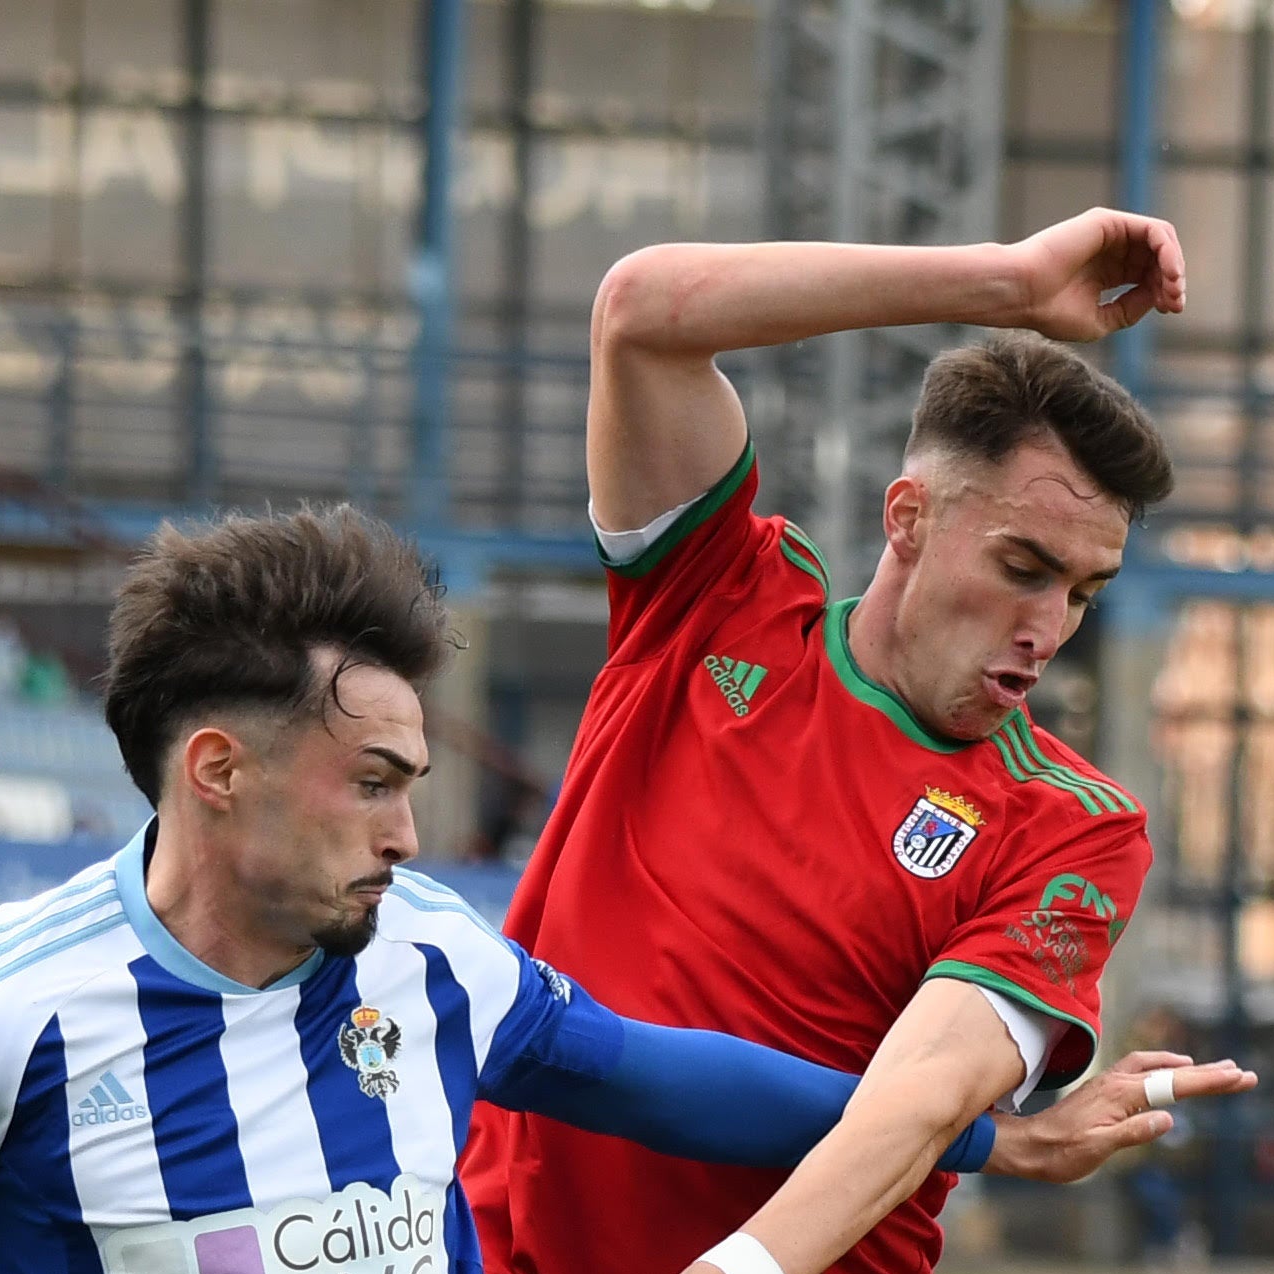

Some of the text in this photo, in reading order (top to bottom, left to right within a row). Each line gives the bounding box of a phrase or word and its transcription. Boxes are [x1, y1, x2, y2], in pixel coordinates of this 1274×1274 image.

[703, 654, 749, 717] adidas
[71, 1105, 146, 1127] adidas
[273, 1188, 436, 1271] Cálida
